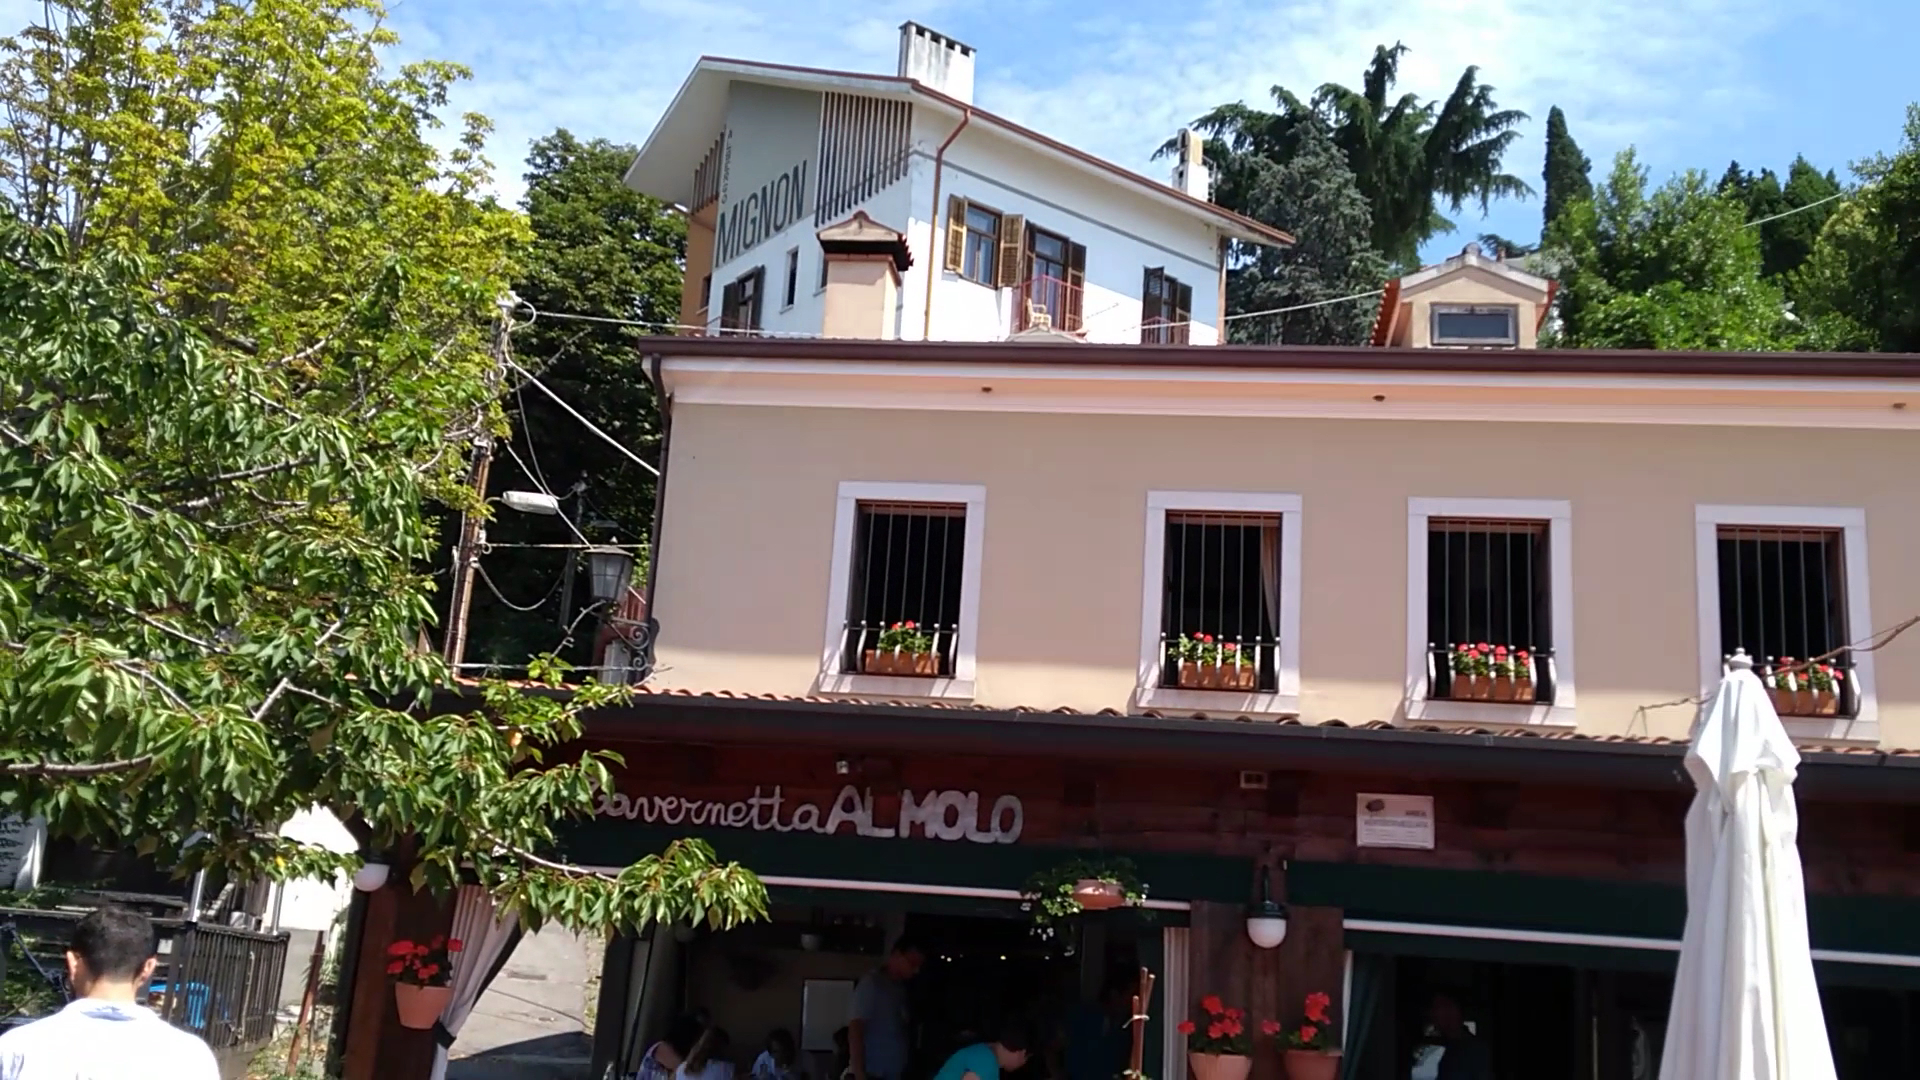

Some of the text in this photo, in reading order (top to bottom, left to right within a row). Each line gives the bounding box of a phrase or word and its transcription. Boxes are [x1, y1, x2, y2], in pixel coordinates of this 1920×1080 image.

[715, 159, 807, 268] MIGNON
[826, 784, 896, 838] AL
[899, 789, 1024, 844] MOLO
